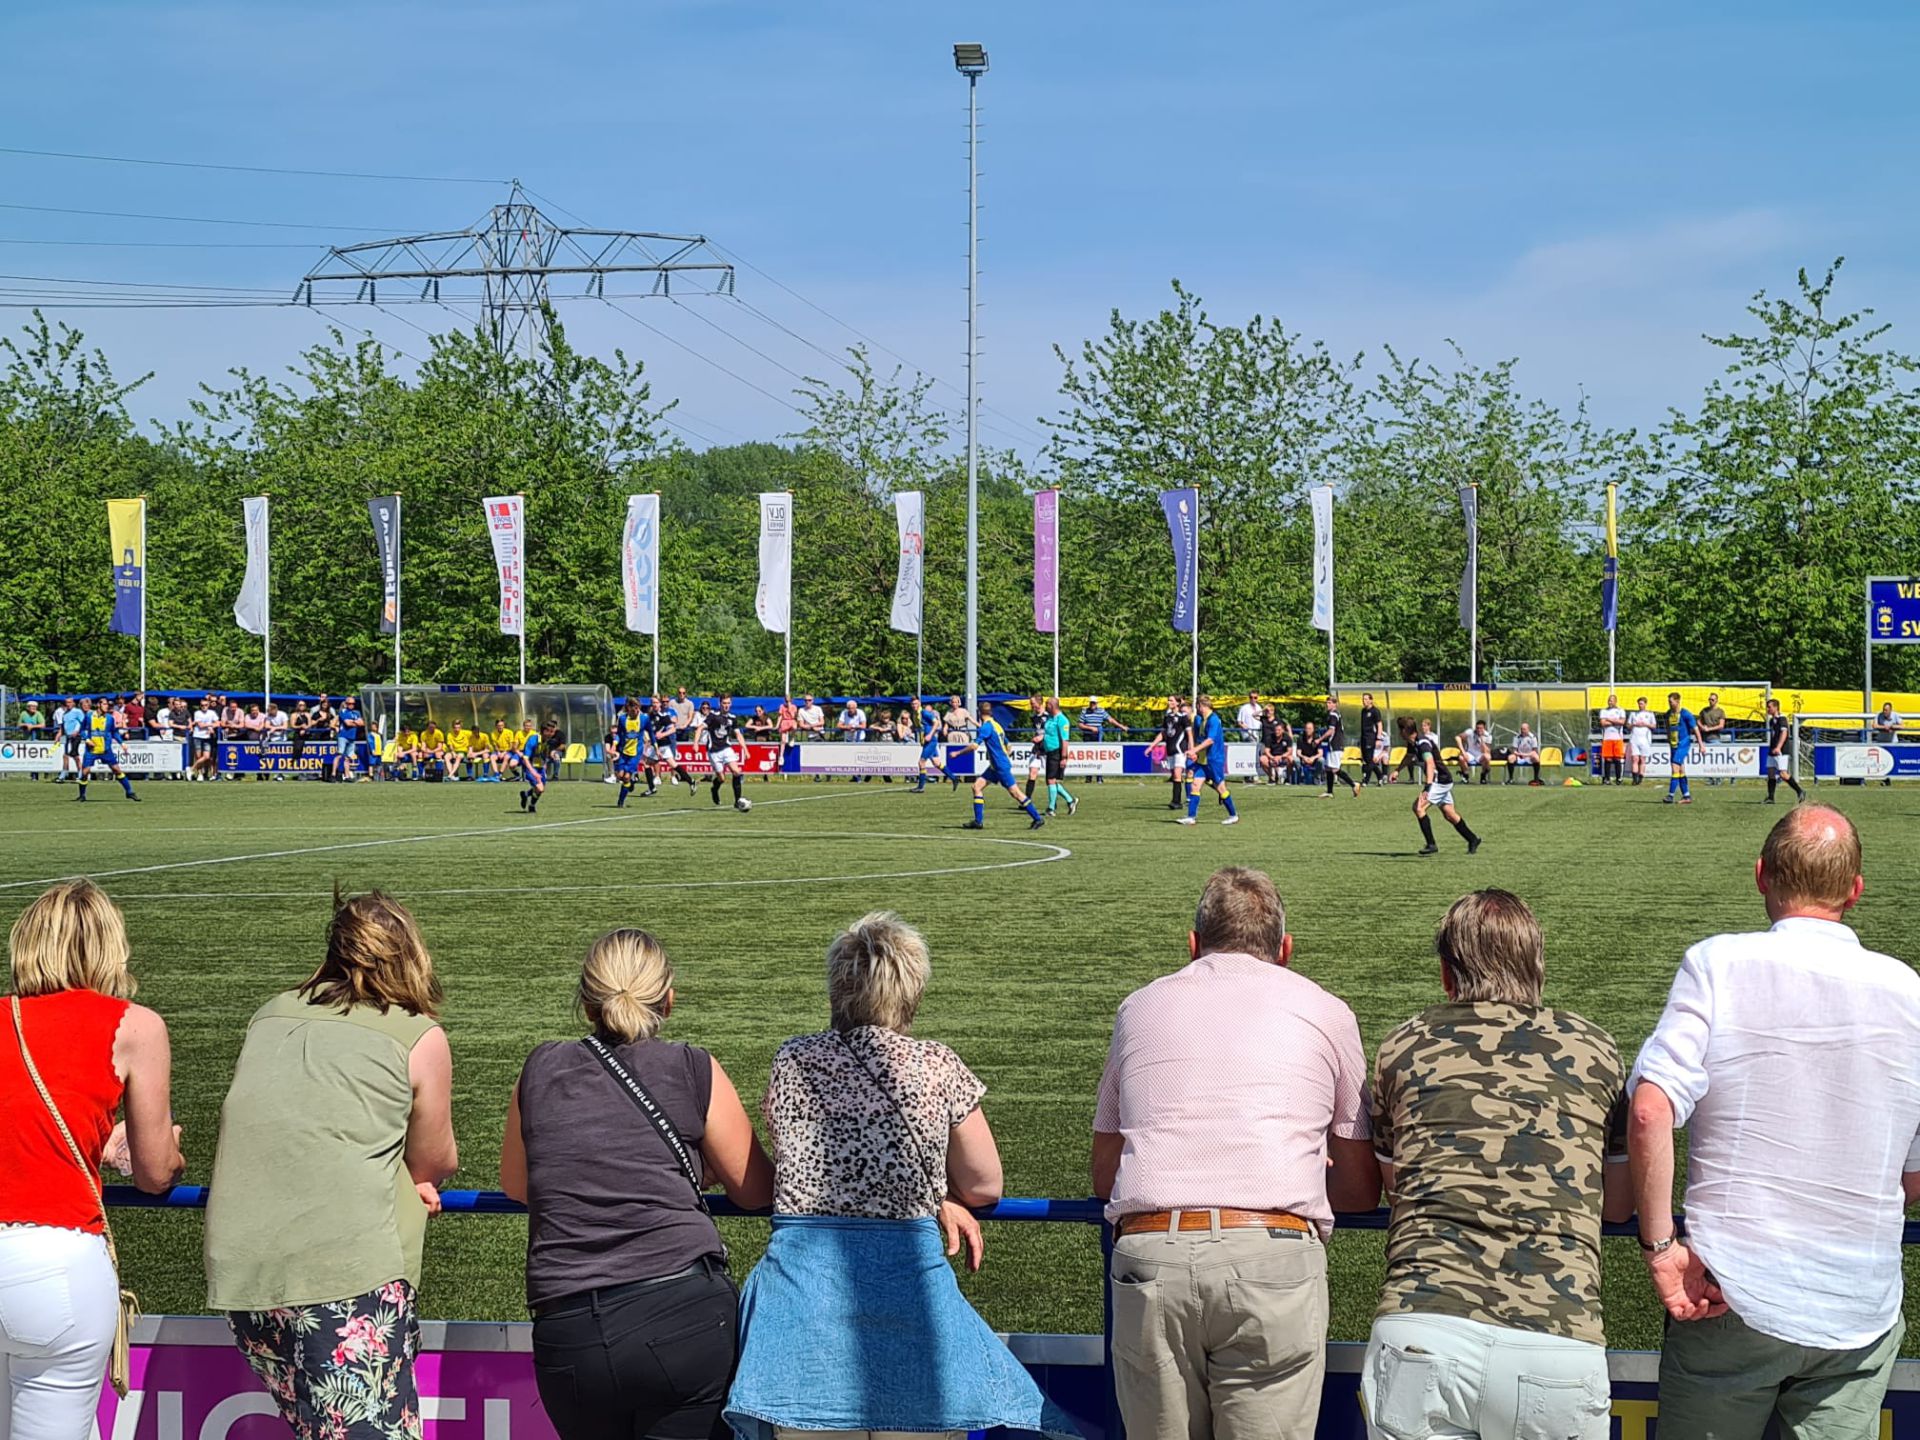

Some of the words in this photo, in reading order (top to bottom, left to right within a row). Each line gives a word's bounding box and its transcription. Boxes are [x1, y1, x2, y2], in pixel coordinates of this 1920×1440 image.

[259, 758, 275, 770] SV
[278, 757, 323, 770] DELDEN
[607, 1057, 628, 1080] NEVER
[625, 1078, 655, 1112] REGULAR
